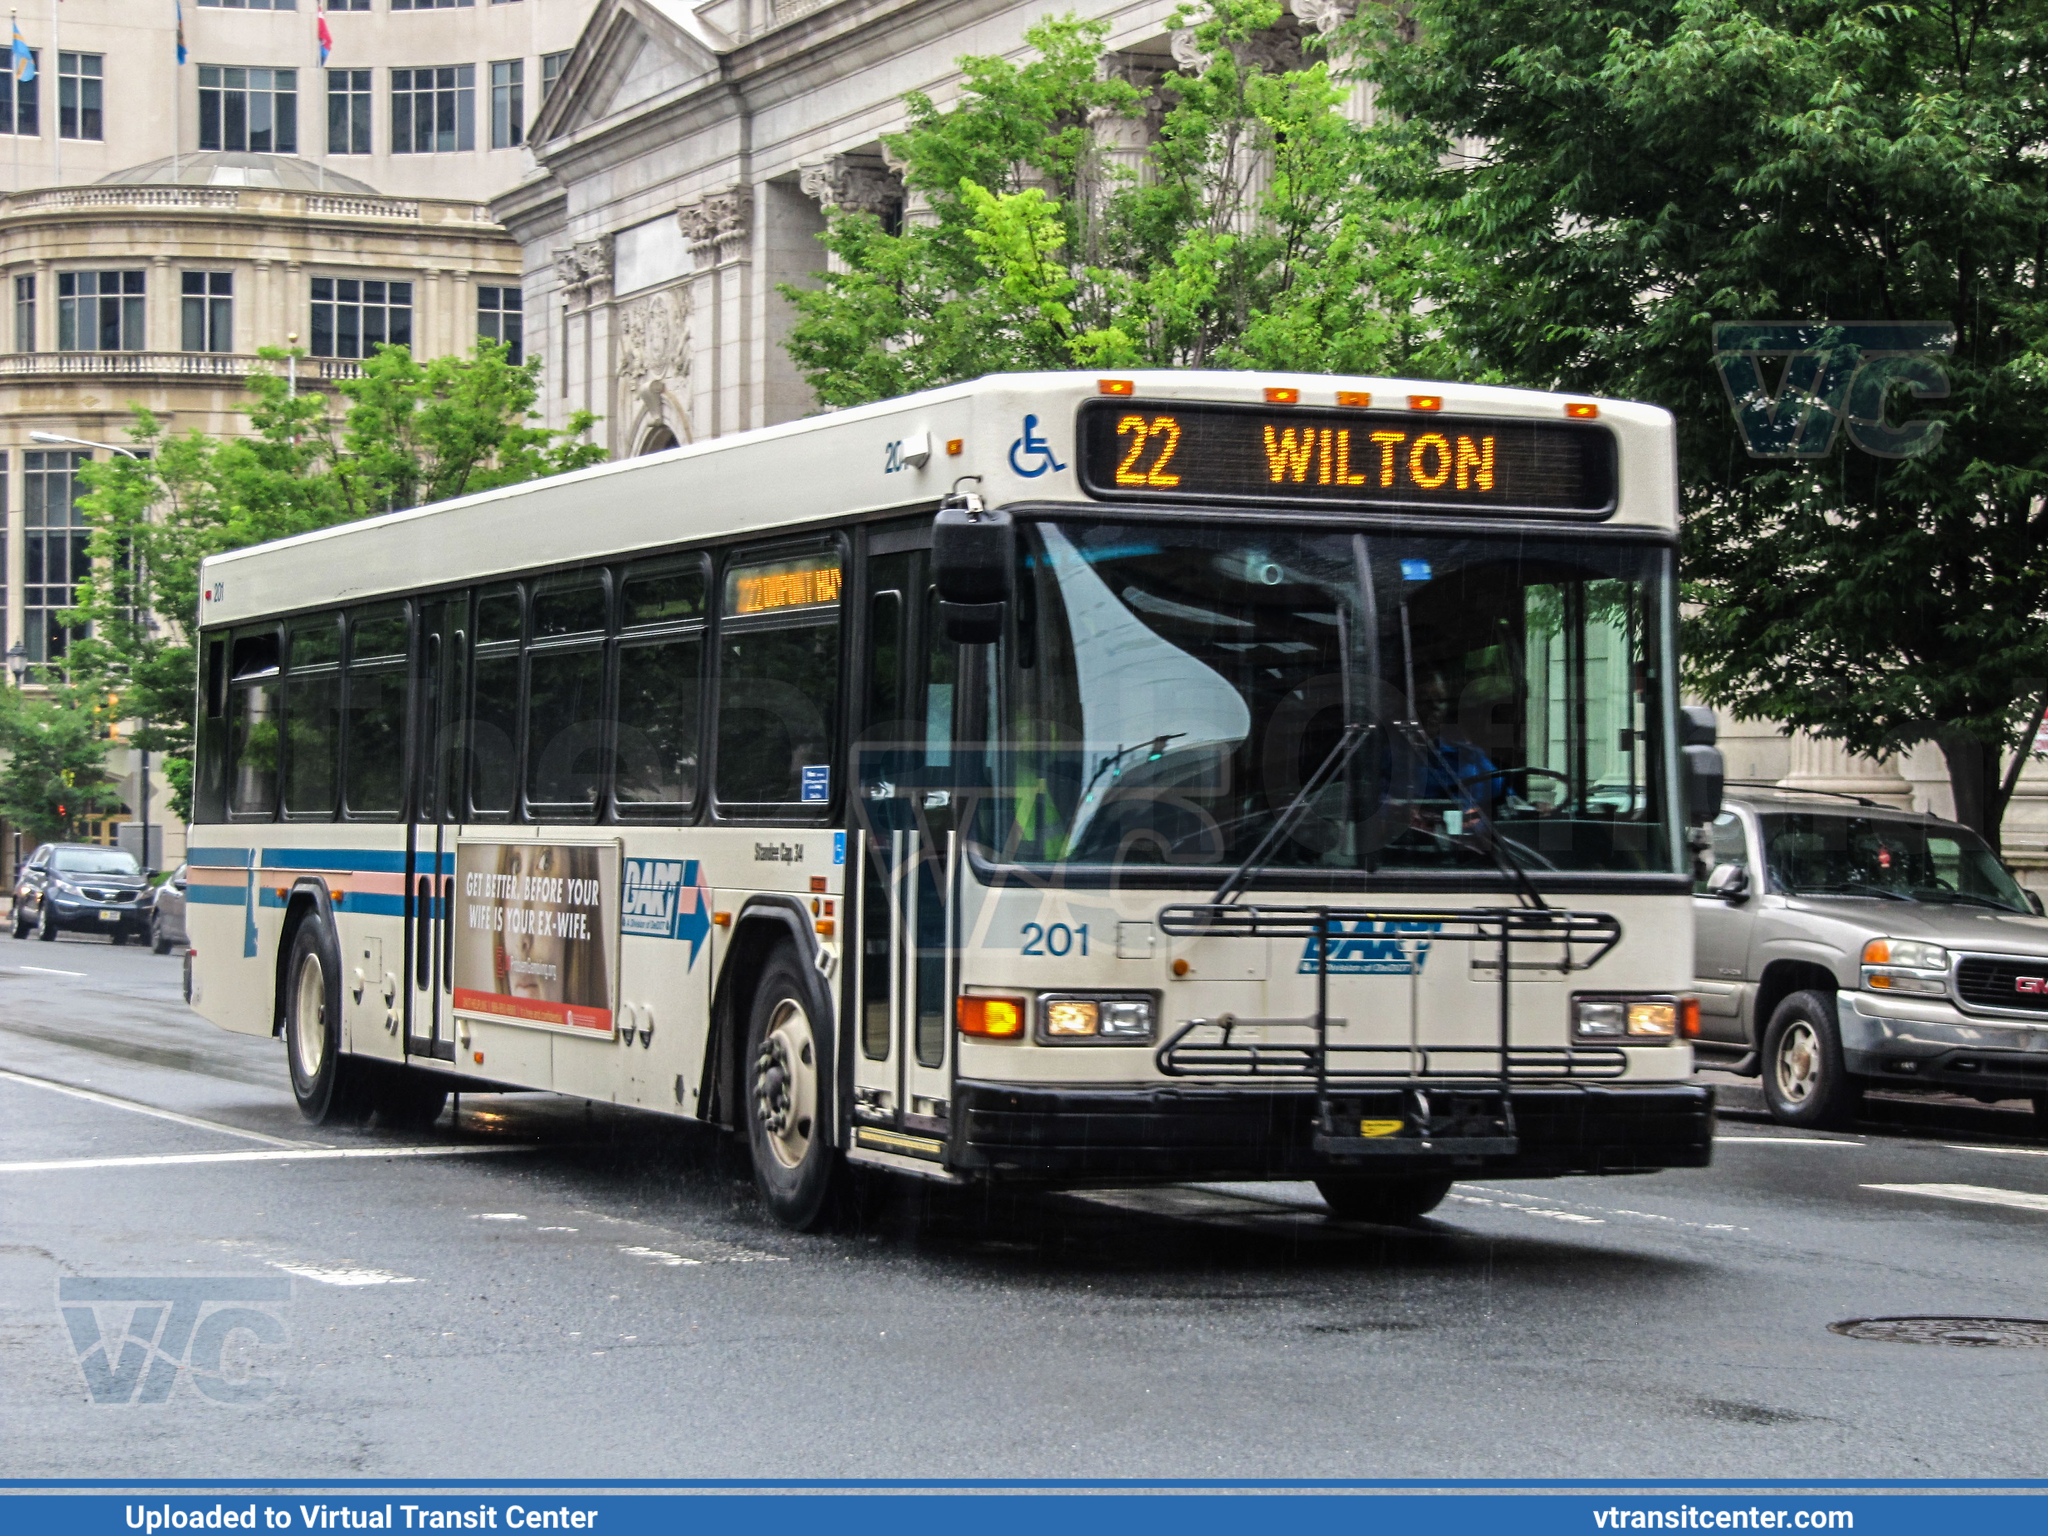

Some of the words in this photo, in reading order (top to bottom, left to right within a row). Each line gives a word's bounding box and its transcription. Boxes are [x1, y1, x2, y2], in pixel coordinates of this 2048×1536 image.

[885, 440, 909, 474] 20
[1116, 415, 1181, 487] 22
[1263, 424, 1495, 492] WILTON
[214, 581, 224, 602] 201
[746, 578, 763, 612] 22
[763, 573, 813, 609] DUPONT
[755, 842, 779, 862] Standee
[466, 872, 483, 897] GET
[485, 873, 520, 900] BETTER.
[524, 875, 564, 904] BEFORE
[567, 878, 600, 906] YOUR
[621, 859, 683, 917] DART
[469, 904, 491, 930] WIFE
[494, 906, 503, 932] IS
[506, 907, 535, 935] YOUR
[538, 909, 591, 941] EX-WIFE.
[1020, 922, 1089, 957] 201
